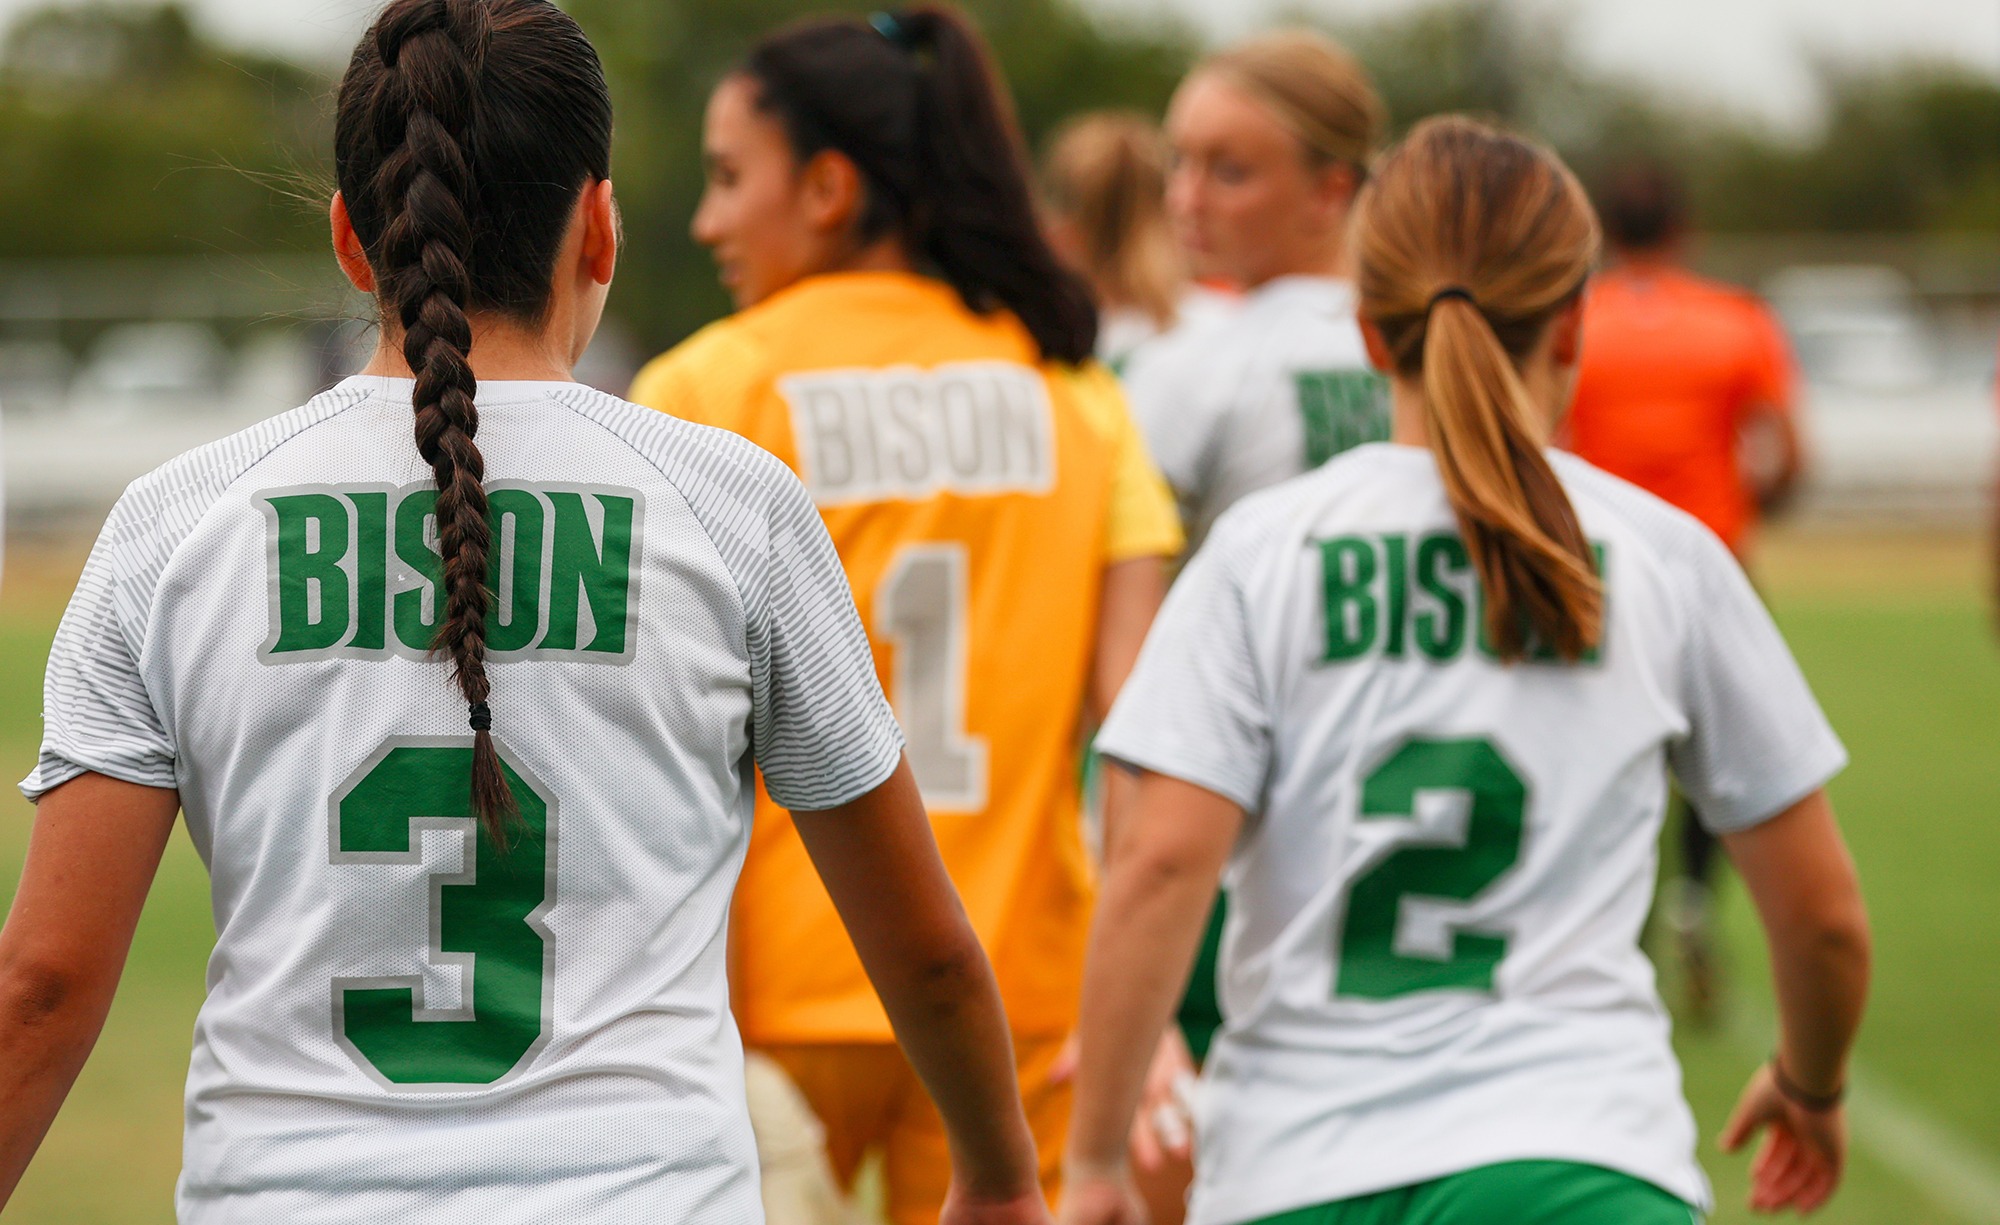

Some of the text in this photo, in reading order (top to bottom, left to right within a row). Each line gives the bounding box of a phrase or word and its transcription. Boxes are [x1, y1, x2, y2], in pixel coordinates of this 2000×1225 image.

[788, 369, 1048, 497] BISON
[262, 486, 637, 657] BISON
[877, 545, 986, 810] 1
[1316, 529, 1608, 664] BIS
[335, 741, 553, 1088] 3
[1333, 737, 1526, 1001] 2
